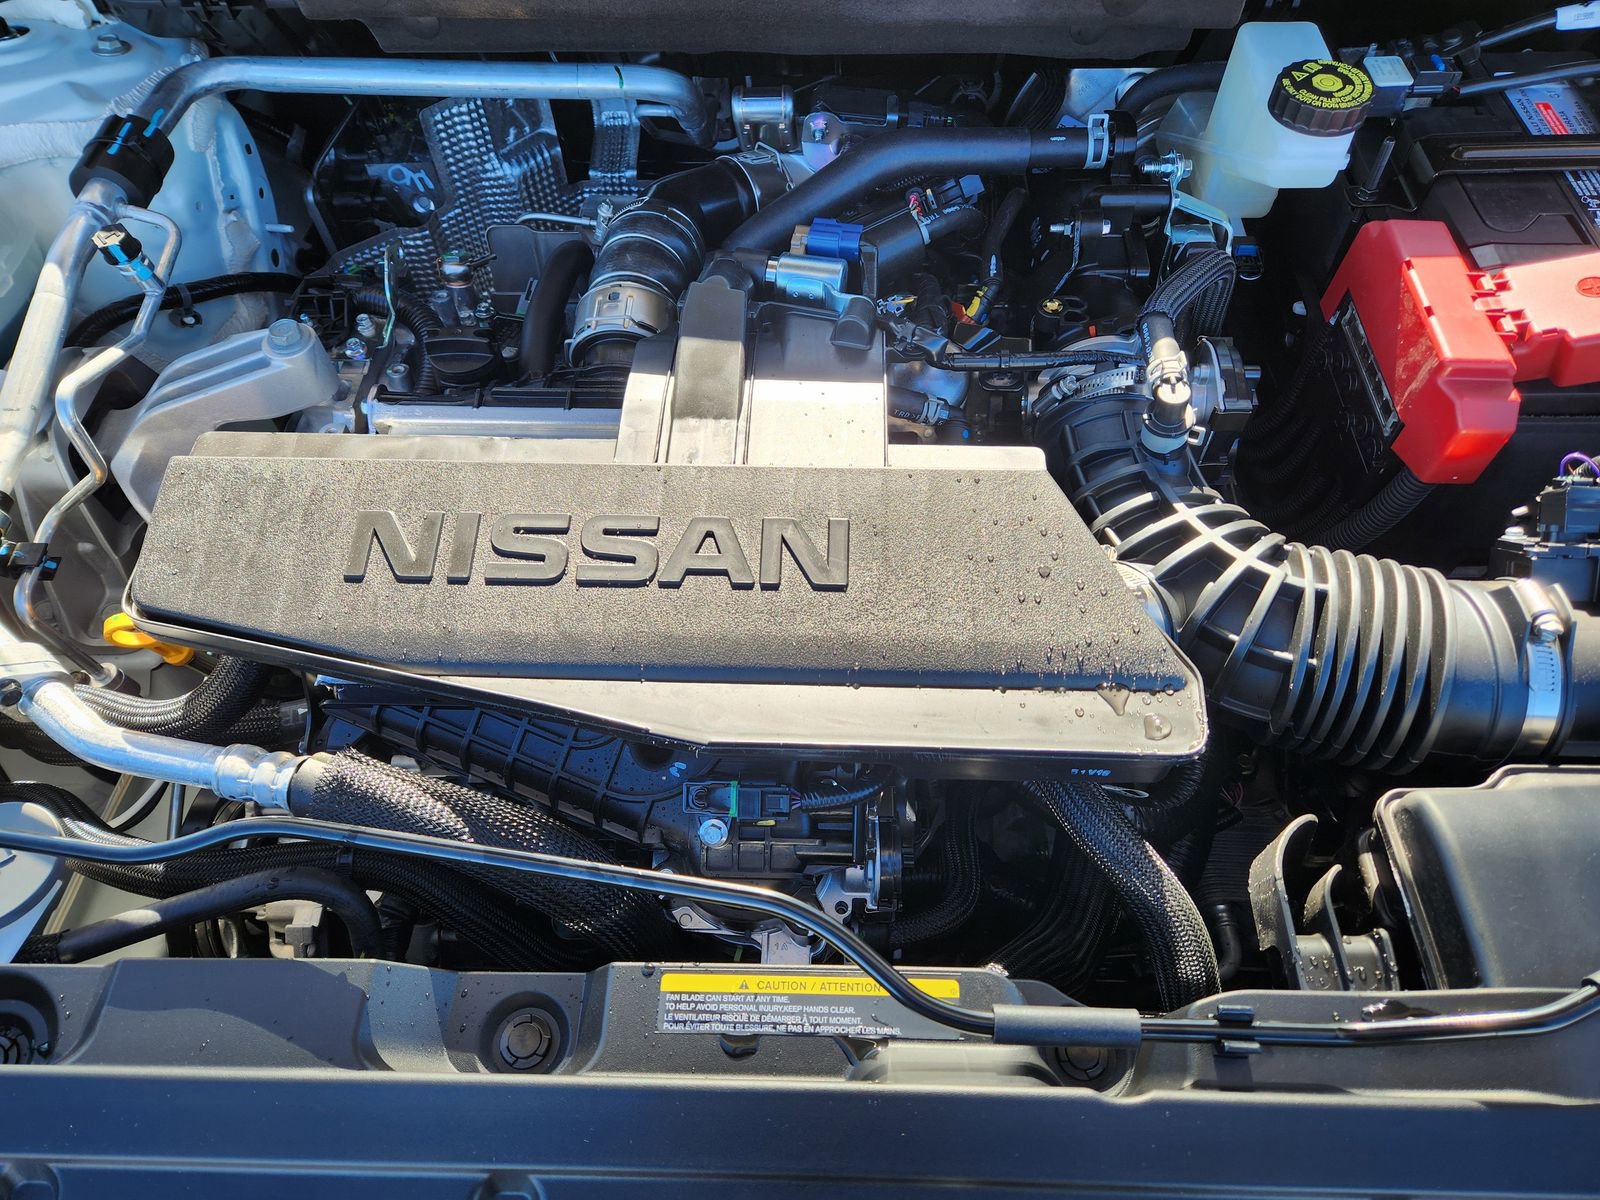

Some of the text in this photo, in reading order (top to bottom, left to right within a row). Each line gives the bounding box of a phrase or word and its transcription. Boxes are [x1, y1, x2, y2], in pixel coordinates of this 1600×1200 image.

[1299, 89, 1318, 100] CLEAN
[343, 510, 849, 591] NISSAN
[756, 980, 806, 991] CAUTION
[820, 982, 881, 993] ATTENTION
[761, 1013, 801, 1024] DÉMARRER
[809, 1016, 828, 1024] TOUT
[685, 1021, 710, 1030] ÉVITER
[711, 1024, 734, 1032] TOUTE
[787, 1025, 803, 1033] PAS
[814, 1026, 860, 1034] APPROCHER
[861, 1027, 876, 1035] LES
